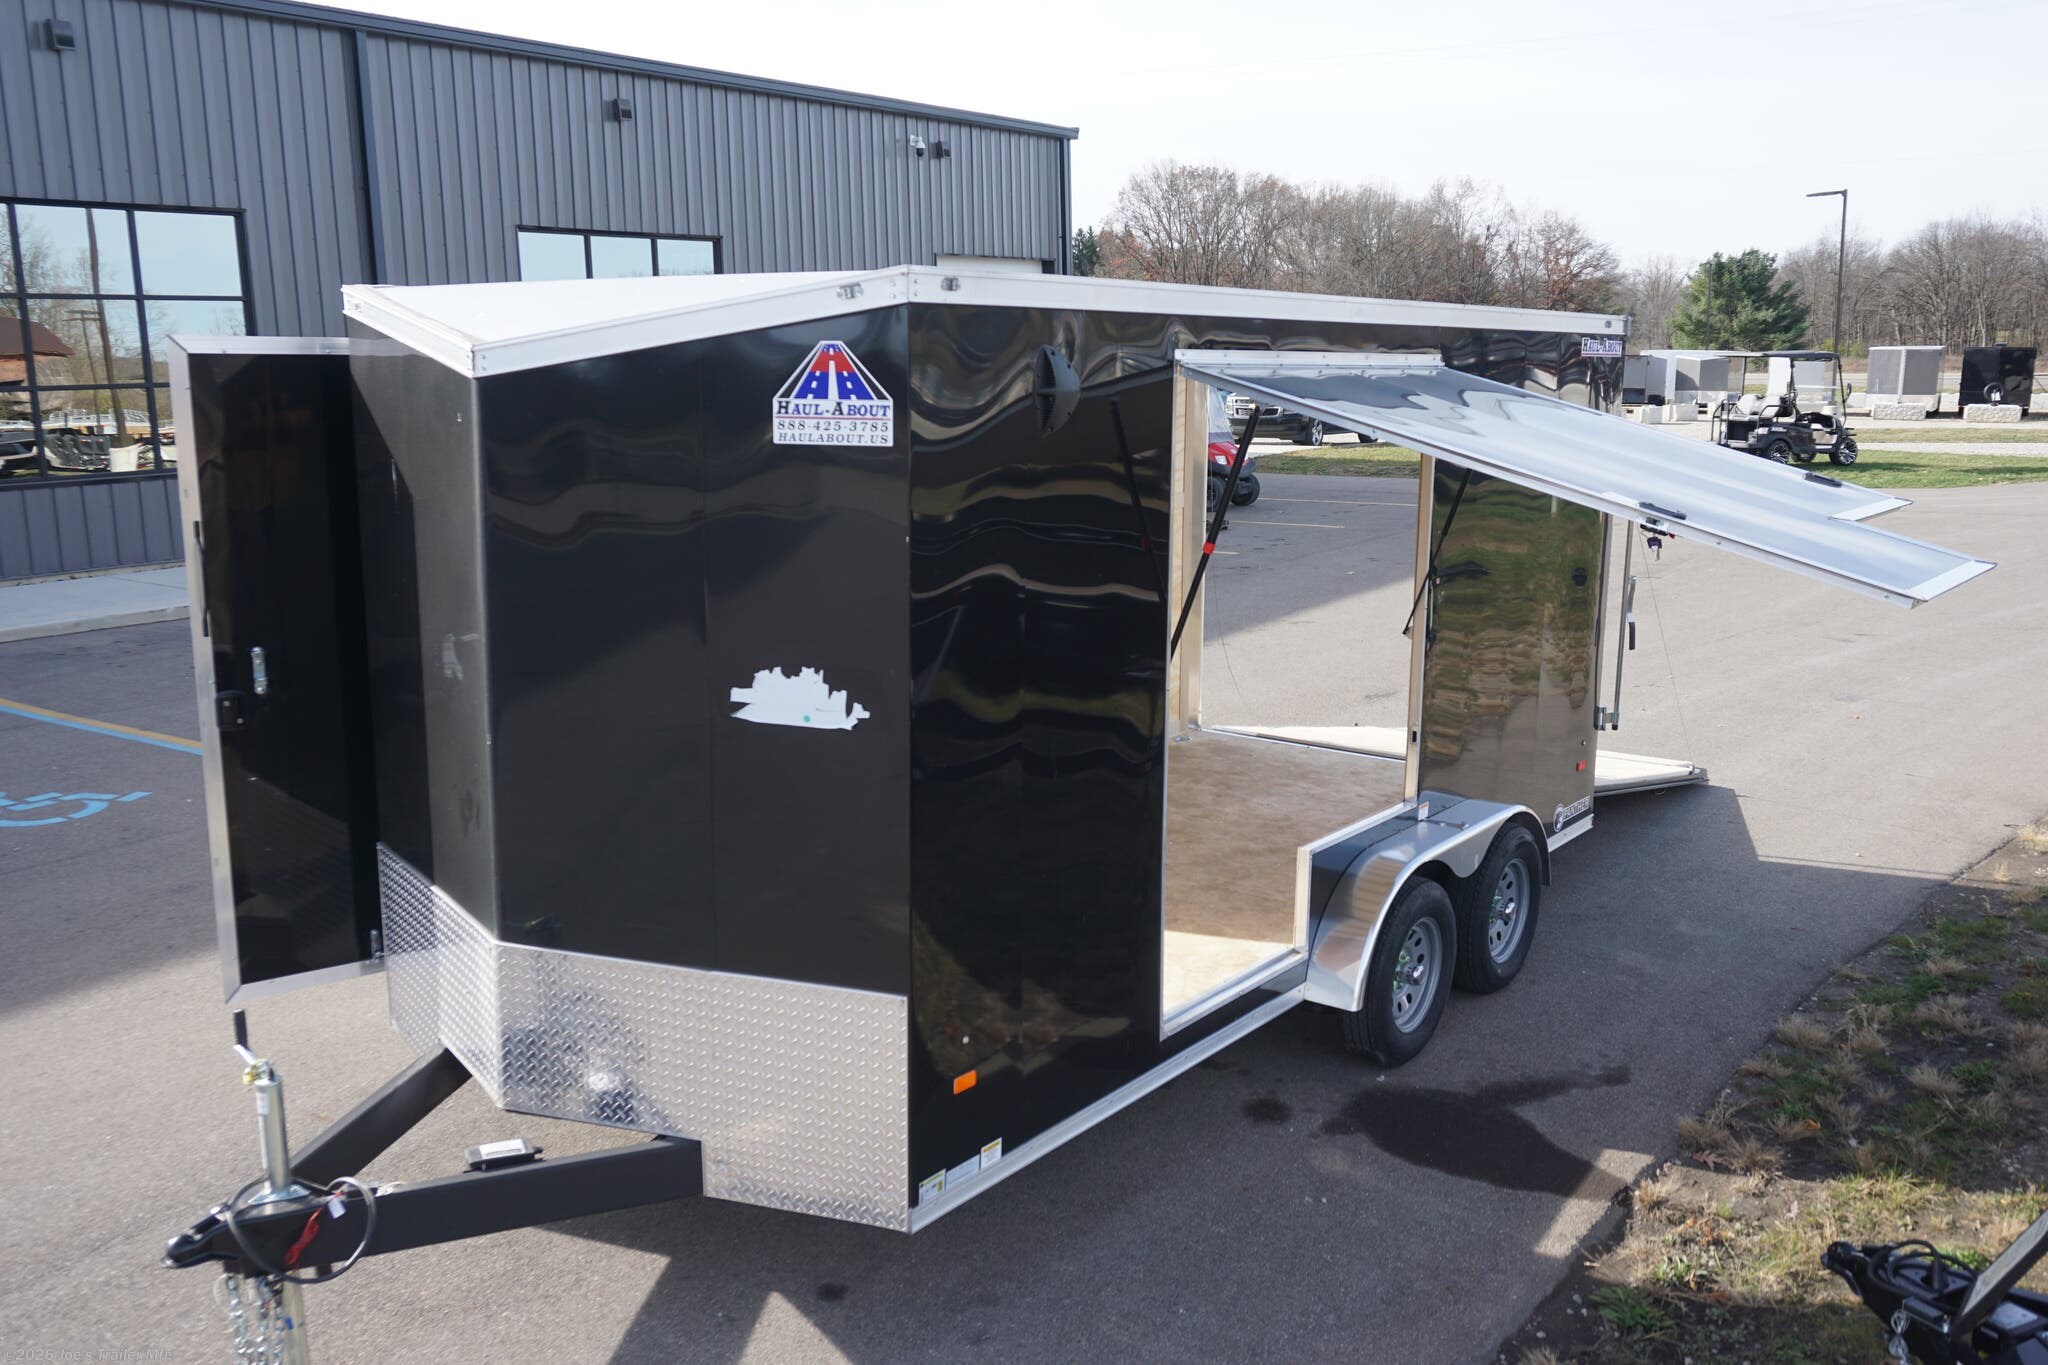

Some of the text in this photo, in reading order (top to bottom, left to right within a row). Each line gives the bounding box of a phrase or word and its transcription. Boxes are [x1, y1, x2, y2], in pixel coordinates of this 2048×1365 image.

[776, 401, 890, 417] HAUL-ABOUT
[777, 420, 889, 432] 888-425-3785
[778, 433, 888, 444] HAULABOUT.US
